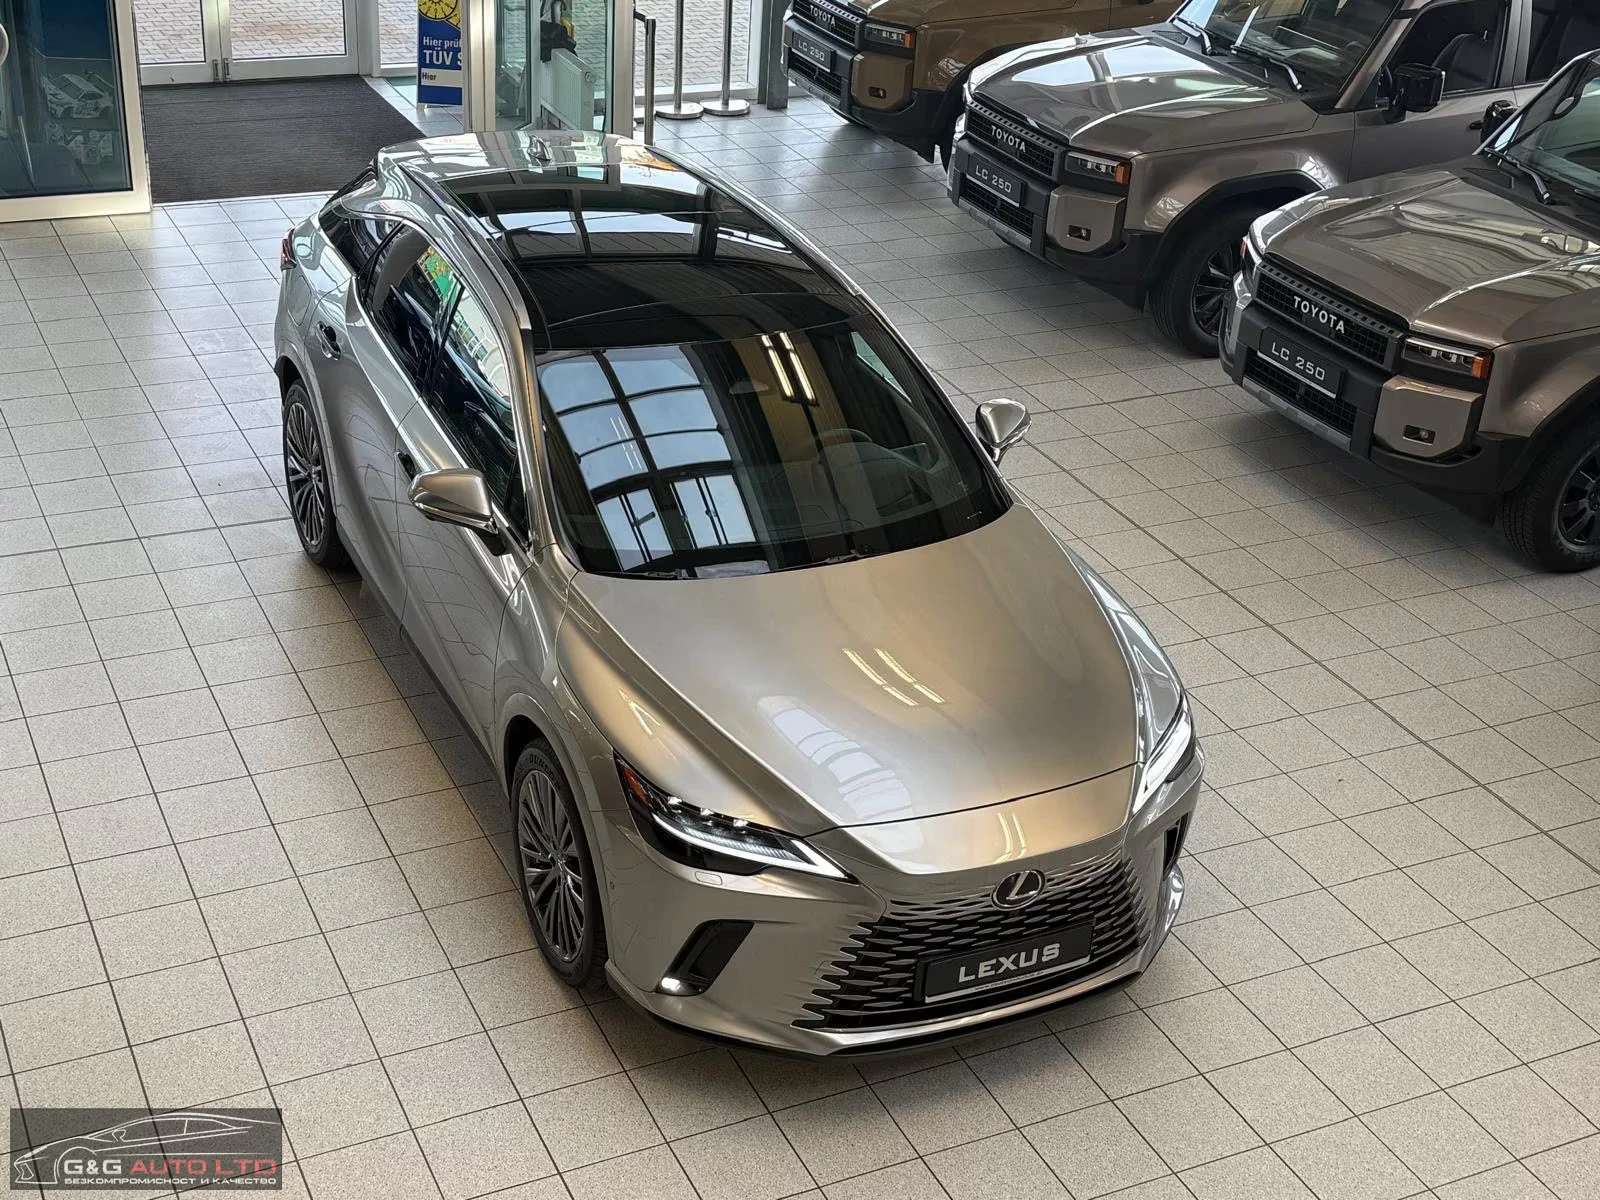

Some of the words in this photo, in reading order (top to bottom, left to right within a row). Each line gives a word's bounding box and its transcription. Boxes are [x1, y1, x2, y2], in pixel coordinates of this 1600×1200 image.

[810, 4, 836, 27] TOYOTA
[423, 36, 442, 47] Hier
[798, 40, 809, 51] LC
[423, 47, 453, 65] TÜV
[422, 72, 437, 81] Hier
[991, 125, 1026, 153] TOYOTA
[975, 165, 990, 180] LC
[1294, 296, 1345, 334] TOYOTA
[1271, 342, 1290, 361] LC
[1295, 356, 1326, 381] 250
[958, 943, 1060, 983] LEXUS
